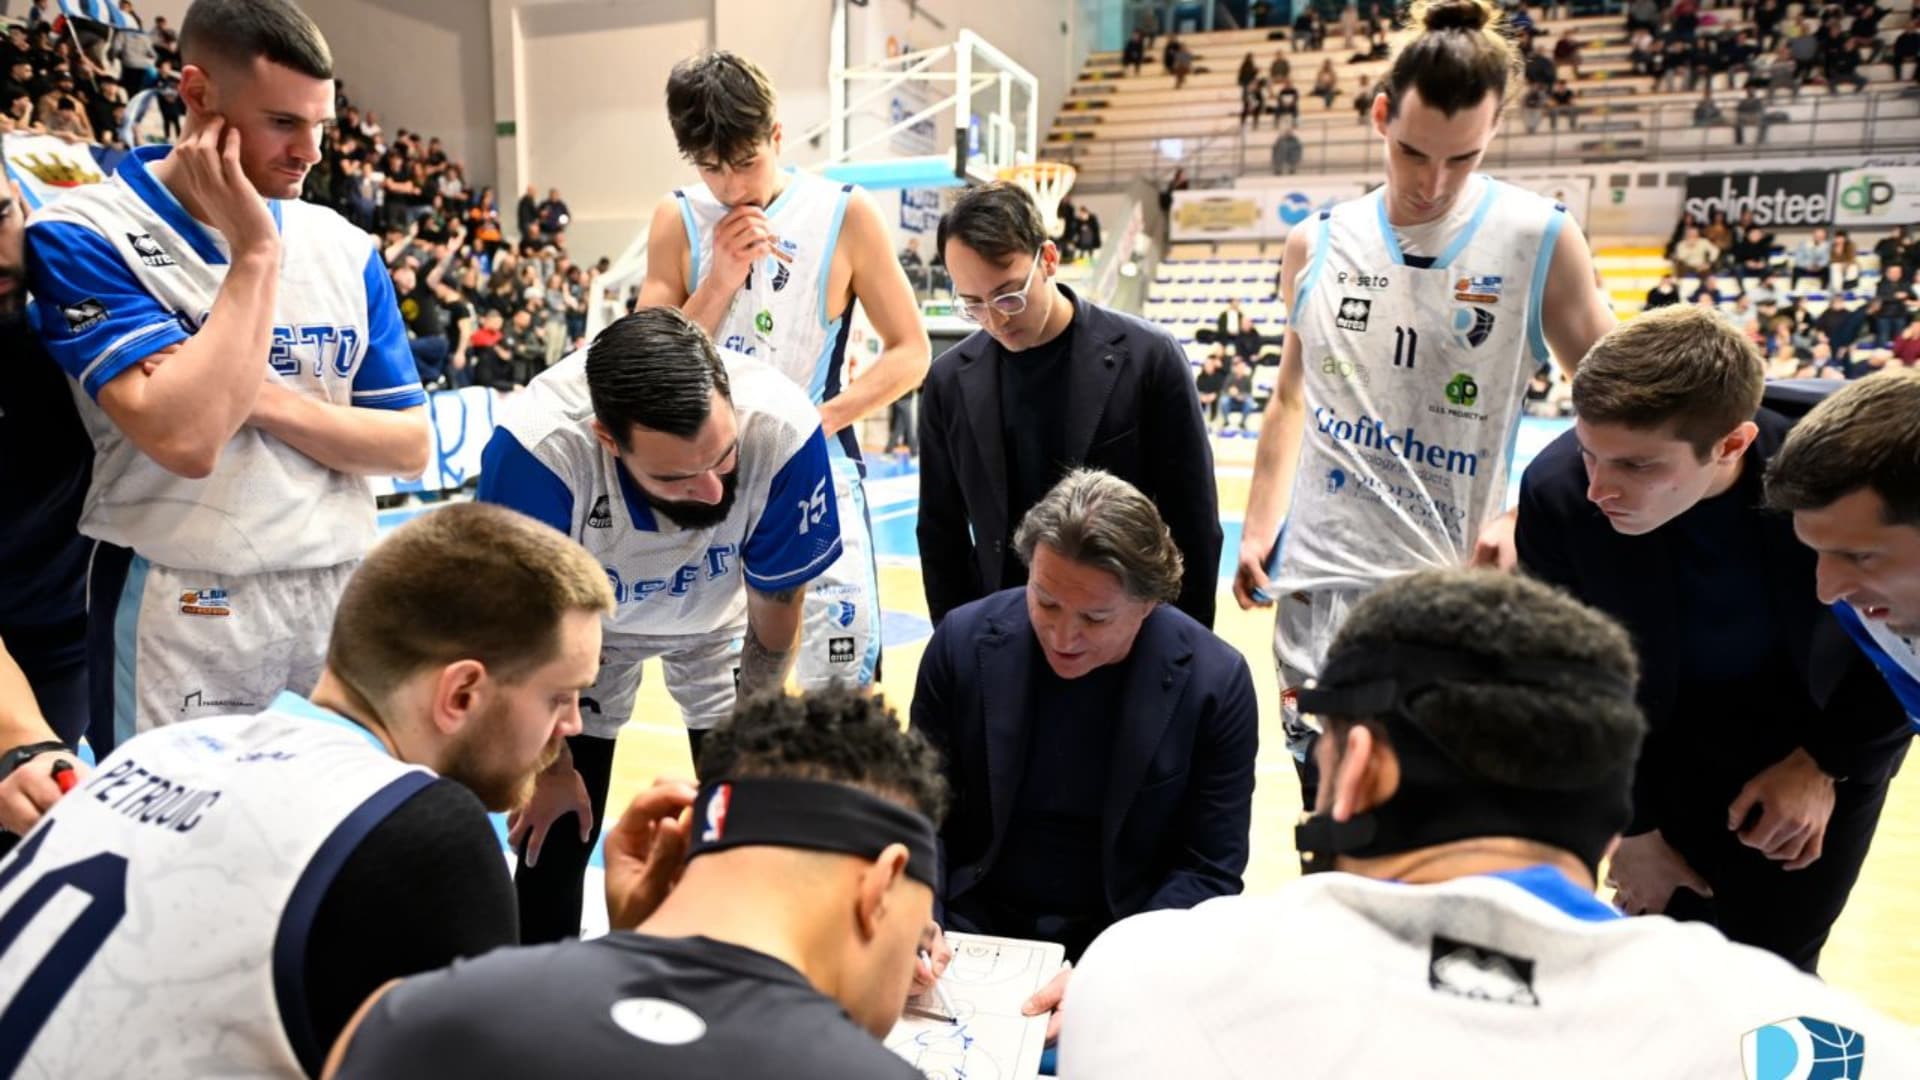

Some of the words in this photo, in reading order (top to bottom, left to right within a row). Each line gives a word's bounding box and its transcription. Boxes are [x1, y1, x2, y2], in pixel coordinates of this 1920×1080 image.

[1685, 174, 1835, 225] solidsteel
[1394, 325, 1418, 369] 11
[797, 477, 829, 535] 15
